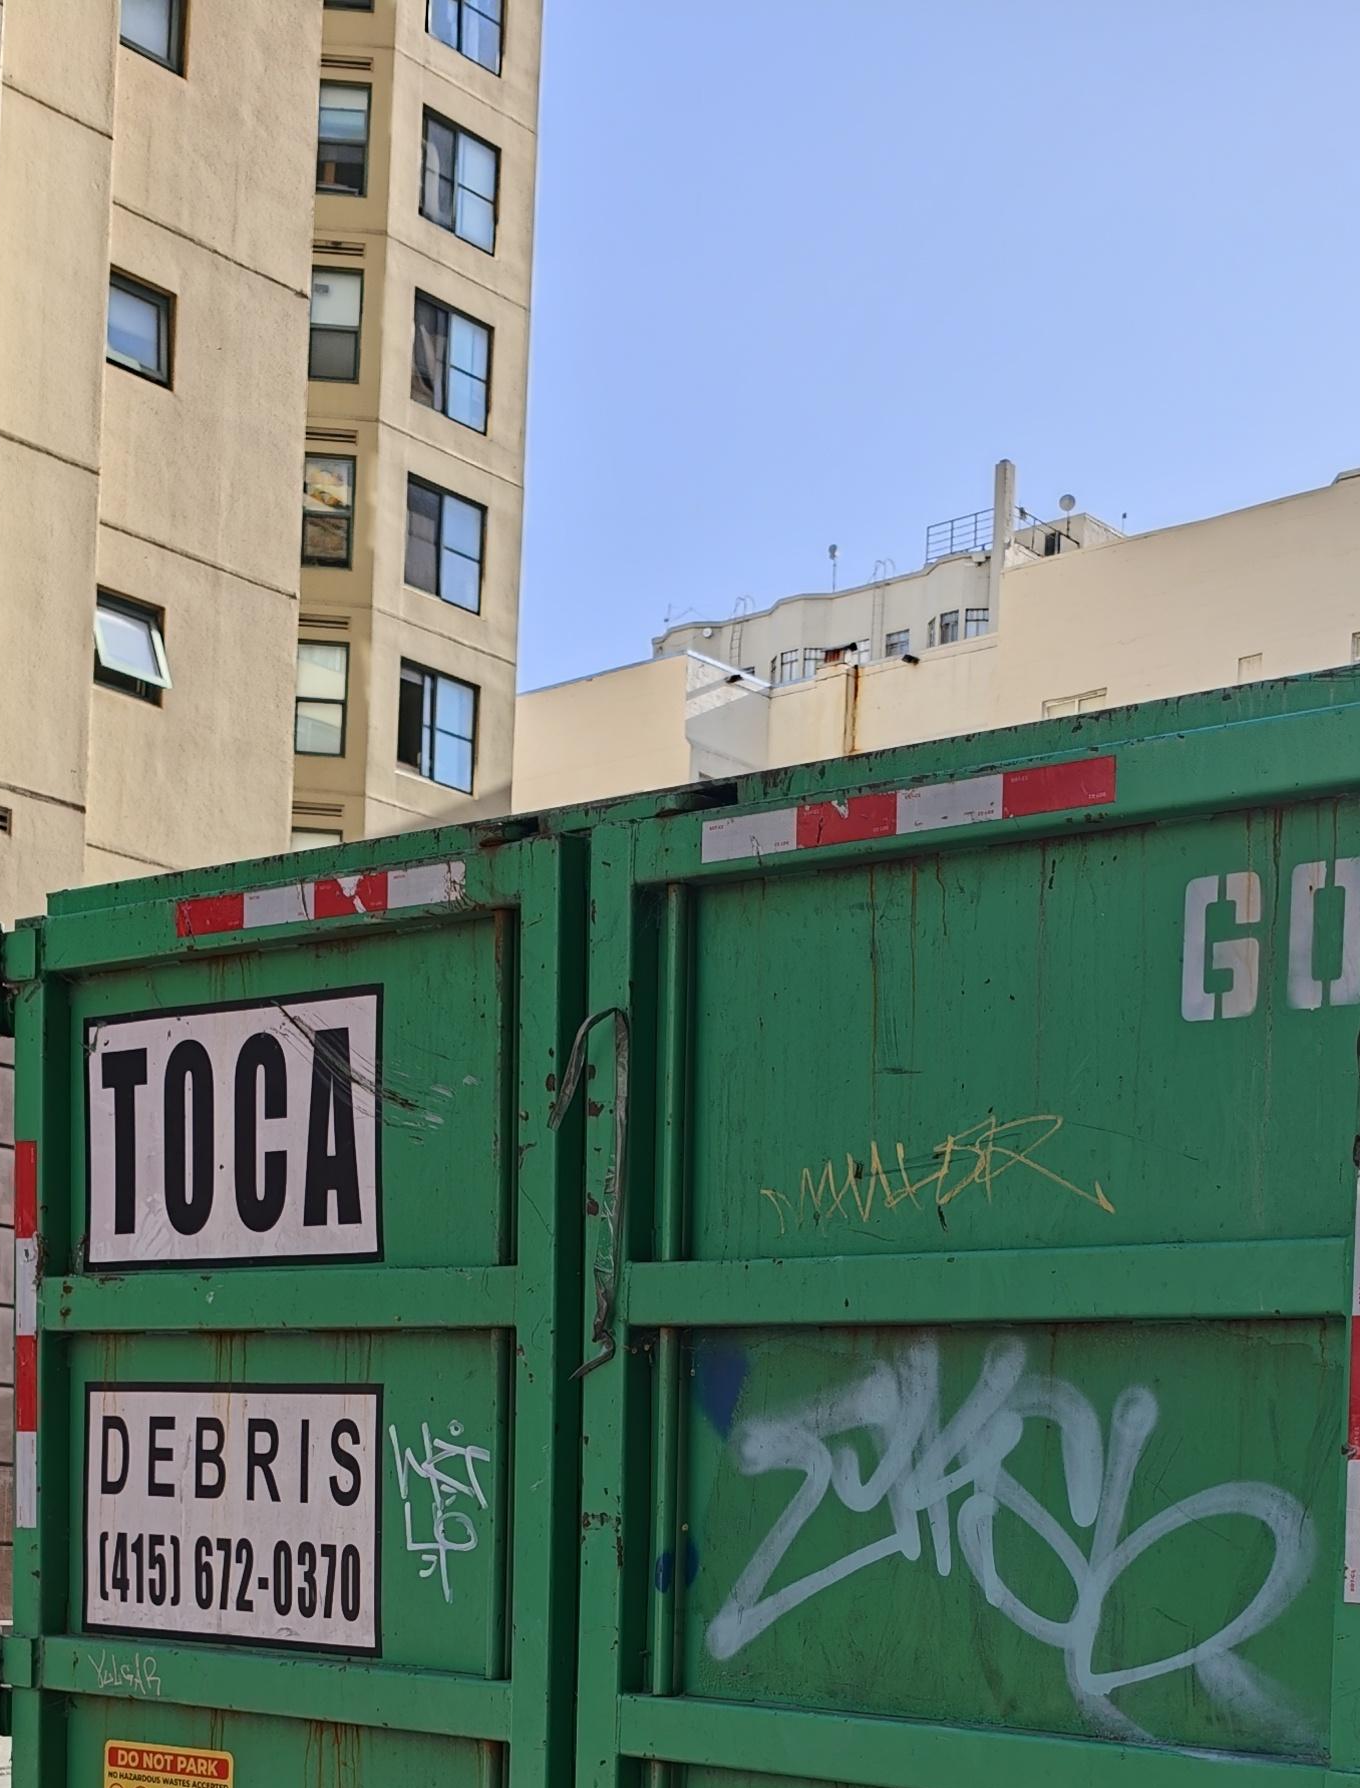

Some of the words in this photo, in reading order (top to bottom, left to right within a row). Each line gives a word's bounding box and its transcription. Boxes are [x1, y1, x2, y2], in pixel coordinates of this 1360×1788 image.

[101, 1027, 362, 1236] TOCA
[101, 1416, 362, 1507] DEBRIS
[100, 1532, 181, 1607] (415)
[195, 1537, 361, 1623] 672-0370
[117, 1749, 140, 1768] DO
[142, 1752, 174, 1772] NOT
[176, 1757, 219, 1777] PARK
[119, 1773, 161, 1784] HAZARDOUS
[162, 1777, 191, 1788] WASTES
